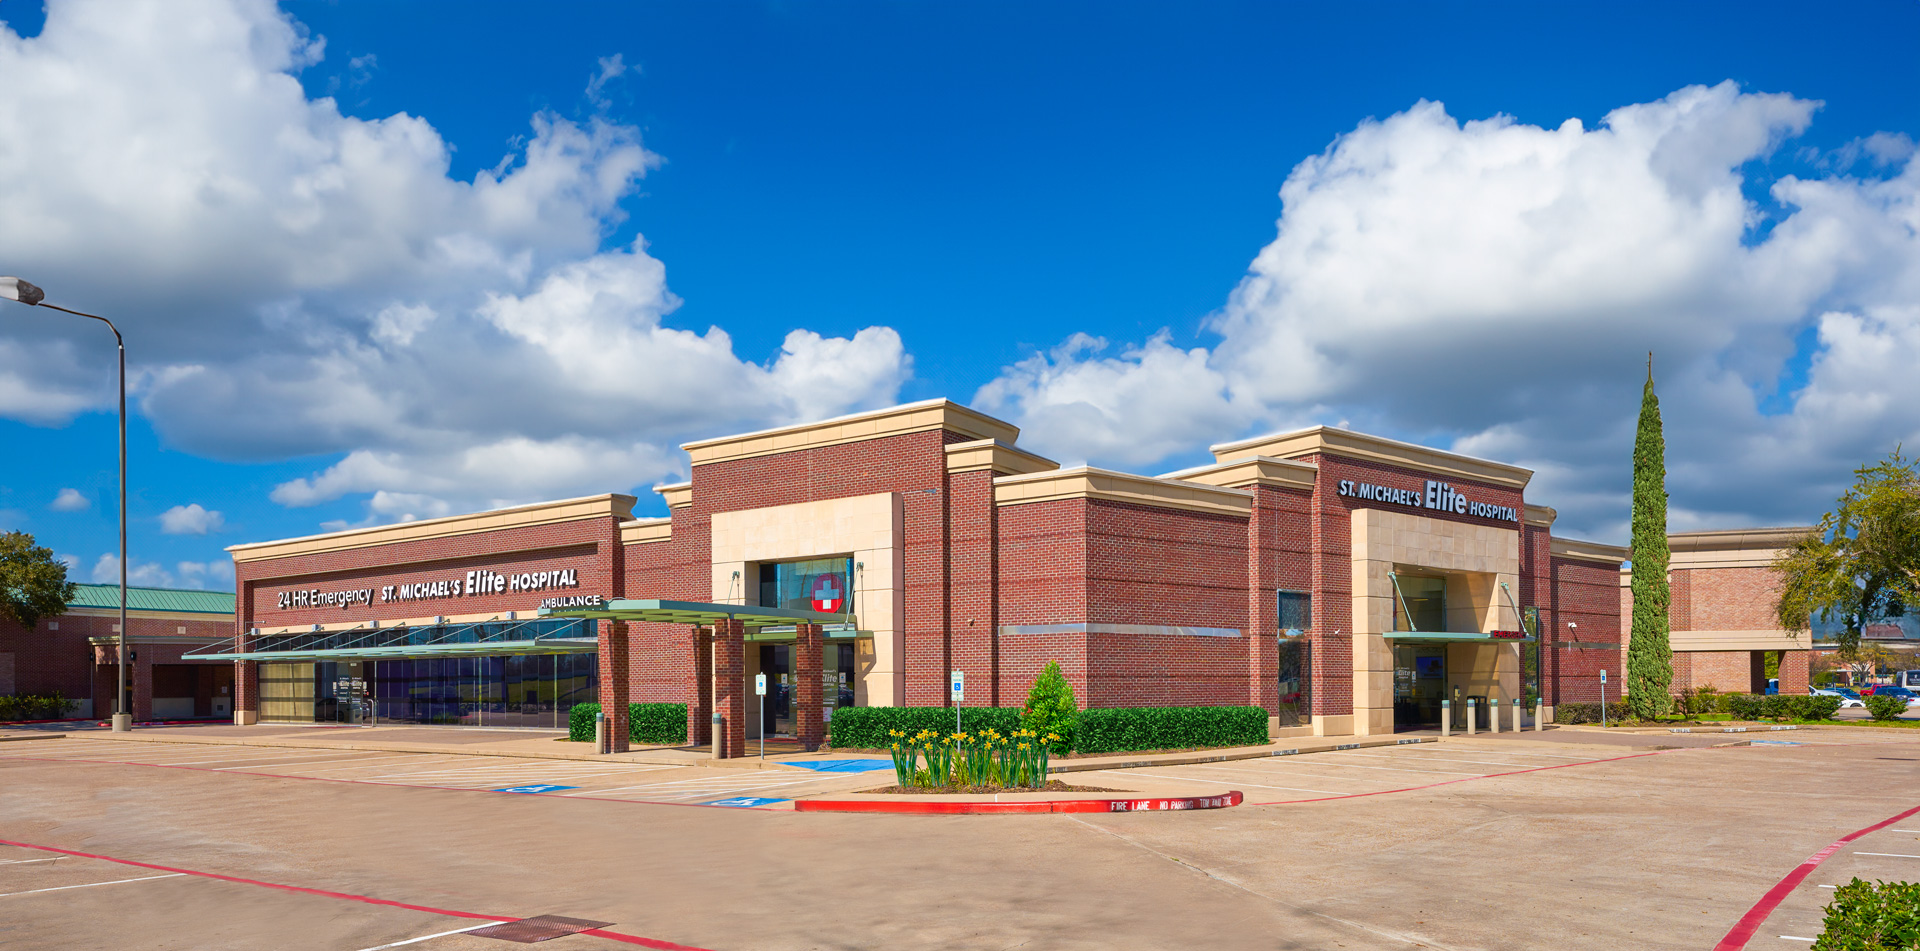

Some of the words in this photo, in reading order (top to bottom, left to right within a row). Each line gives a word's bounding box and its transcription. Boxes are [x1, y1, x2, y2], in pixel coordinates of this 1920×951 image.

[1339, 479, 1356, 497] ST.
[1358, 482, 1421, 507] MICHAEL'S
[1425, 480, 1467, 514] Elite
[1469, 501, 1518, 522] HOSPITAL
[381, 585, 397, 601] ST.
[400, 579, 461, 600] MICHAEL'S
[465, 570, 505, 594] Elite
[510, 568, 577, 590] HOSPITAL
[278, 591, 291, 608] 24
[293, 590, 308, 607] HR
[311, 588, 372, 608] Emergency
[541, 595, 601, 609] AMBULANCE
[1111, 801, 1128, 811] FIRE
[1132, 800, 1150, 811] LANE
[1159, 800, 1168, 810] NO
[1171, 800, 1194, 810] PARKING
